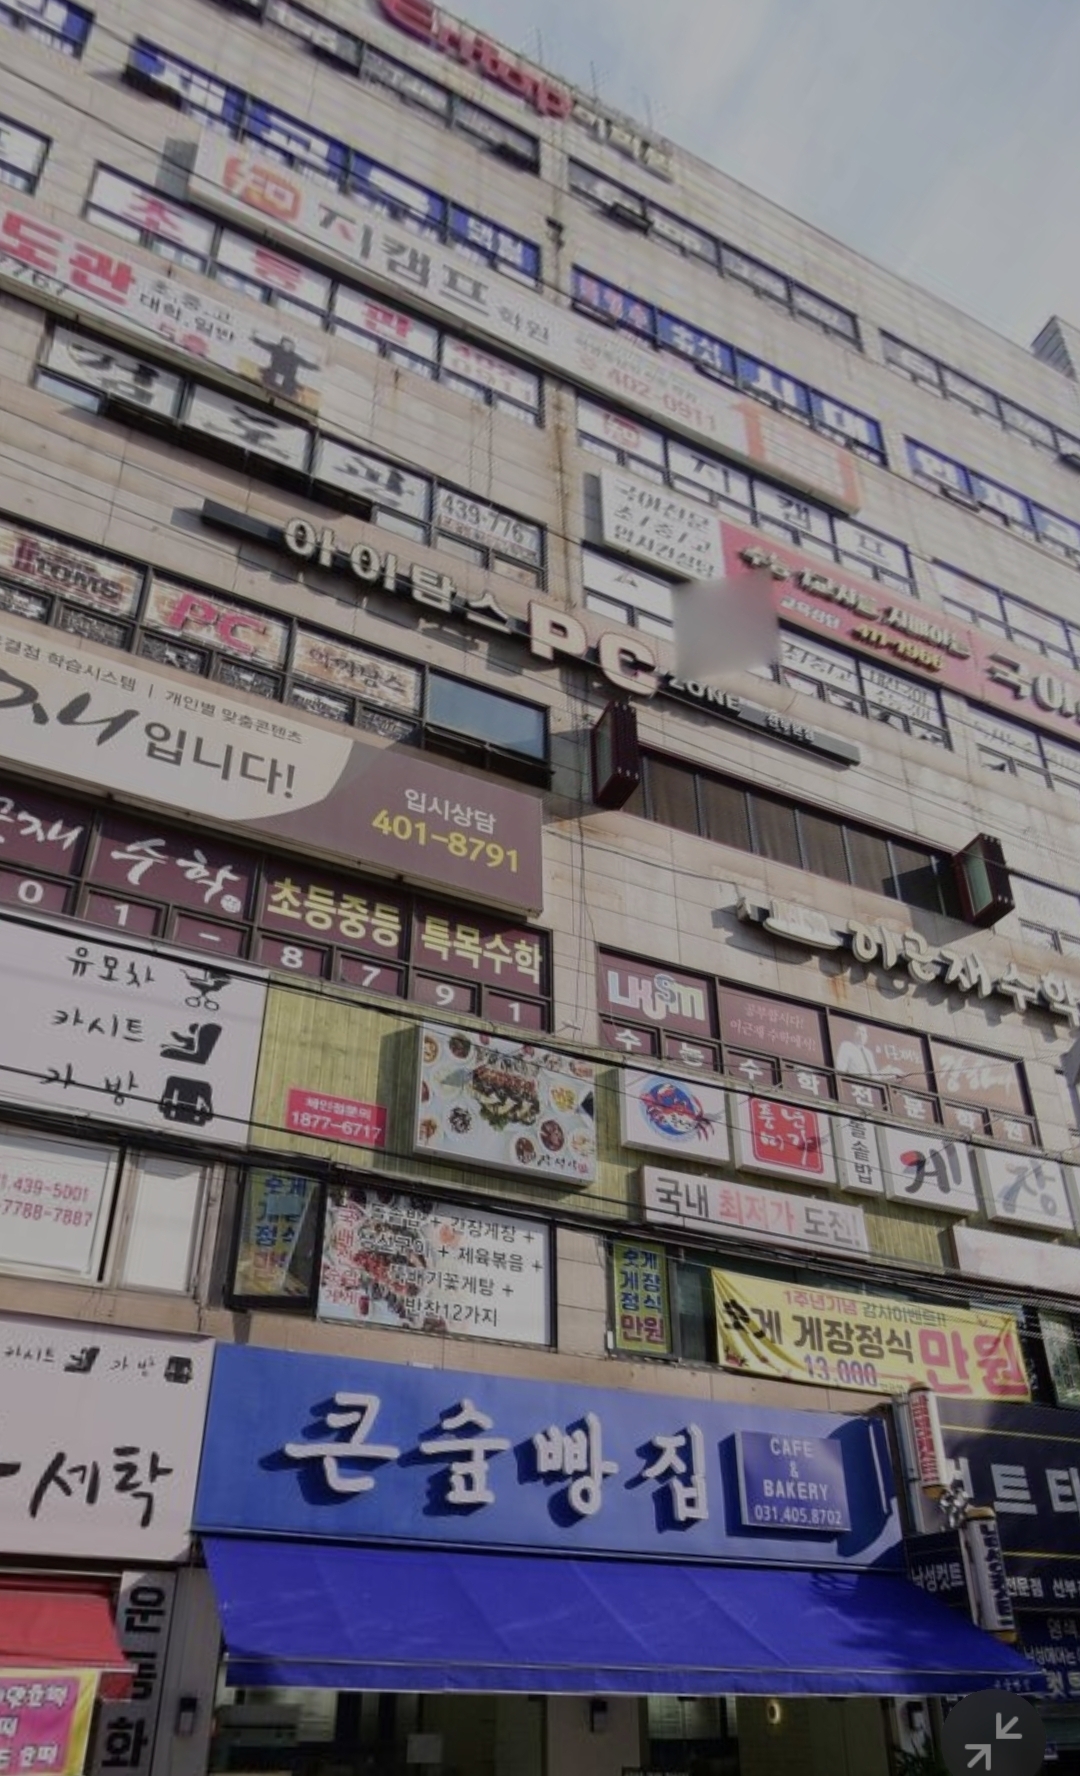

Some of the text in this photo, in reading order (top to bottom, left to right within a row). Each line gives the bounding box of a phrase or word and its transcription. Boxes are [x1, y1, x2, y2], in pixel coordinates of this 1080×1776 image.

[318, 204, 490, 316] 지캠프
[167, 592, 265, 655] PC
[527, 599, 658, 697] PC
[47, 651, 138, 692] 학습시스템
[165, 688, 217, 718] 개인별
[144, 721, 297, 800] 입니다!
[404, 788, 495, 834] 입시상담
[371, 809, 518, 873] 401-8791
[267, 877, 544, 985] 초등중등 특목수학
[66, 947, 156, 987] 유모차
[280, 945, 304, 970] 8
[361, 964, 383, 988] 7
[436, 983, 455, 1006] 9
[508, 1002, 523, 1022] 1
[51, 1007, 145, 1042] 카시트
[291, 1111, 382, 1140] 1877-6717
[656, 1176, 710, 1219] 국내
[719, 1188, 795, 1236] 최저가
[449, 1215, 517, 1243] 간장게장
[459, 1245, 525, 1274] 제육볶음
[620, 1270, 662, 1293] 게장
[405, 1297, 499, 1328] 반찬12가지
[621, 1291, 663, 1314] 정식
[783, 1288, 858, 1317] 1주년기념
[621, 1314, 667, 1345] 만원
[793, 1313, 914, 1362] 게장정식
[918, 1326, 1029, 1396] 만원
[769, 1436, 815, 1458] CAFE
[28, 1443, 174, 1529] 세탁
[789, 1460, 800, 1479] &
[762, 1478, 829, 1502] BAKERY
[753, 1504, 843, 1526] 031.405.8702
